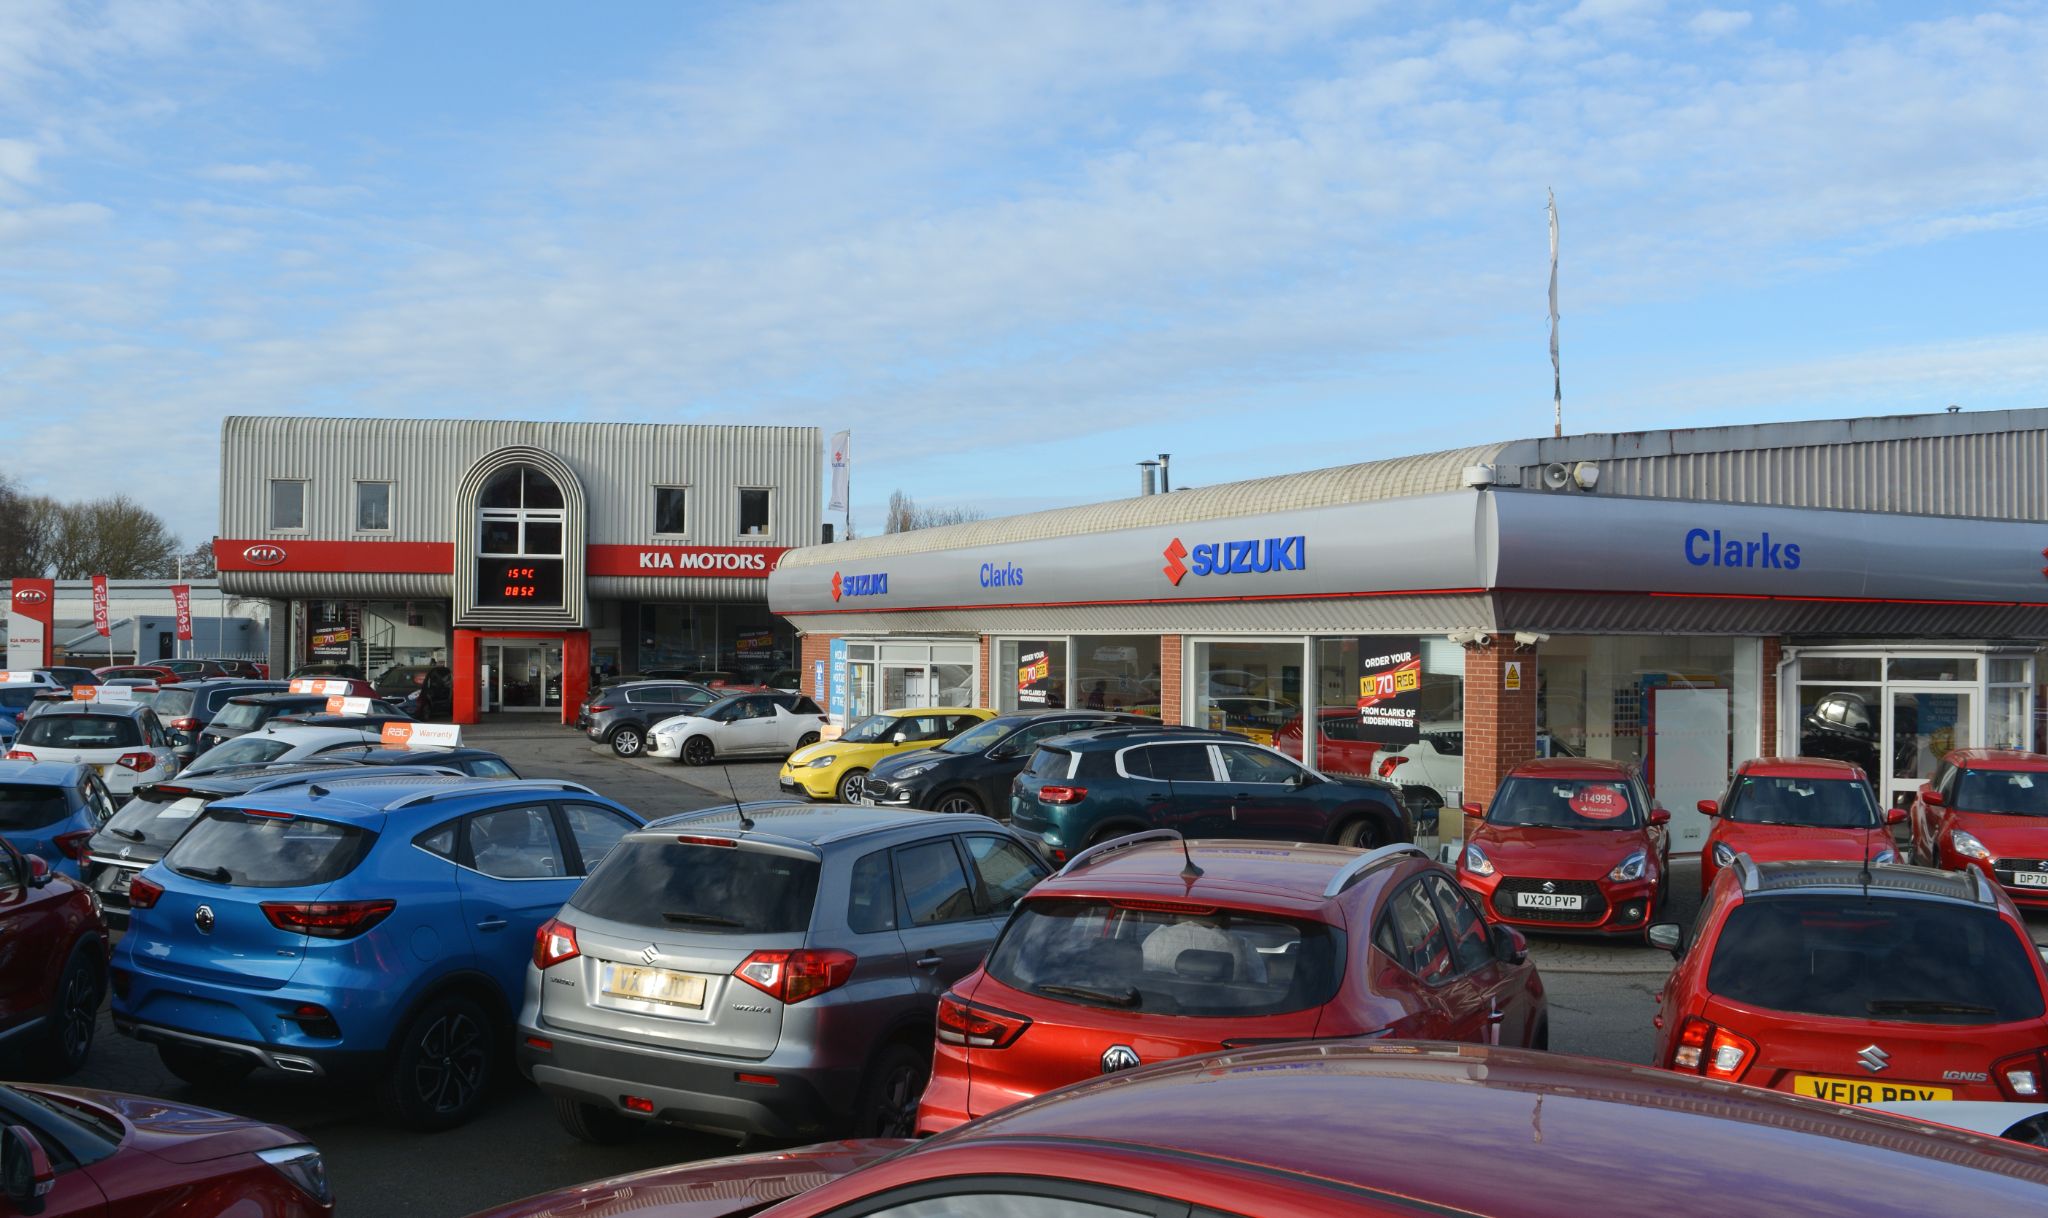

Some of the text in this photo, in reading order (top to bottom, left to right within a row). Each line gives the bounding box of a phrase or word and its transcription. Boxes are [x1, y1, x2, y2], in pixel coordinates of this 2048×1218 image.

[1192, 536, 1305, 576] SUZUKI
[1685, 528, 1800, 570] Clarks
[639, 553, 674, 568] KIA
[680, 553, 765, 569] MOTORS
[980, 562, 1023, 587] Clarks
[843, 573, 887, 596] SUZUKI
[324, 635, 334, 643] 70
[1365, 652, 1412, 668] ORDER YOUR
[1028, 666, 1036, 680] 70
[1363, 673, 1414, 694] NU 70 REG
[1362, 706, 1416, 718] FROM CLARKS OF
[1363, 716, 1414, 728] KIDDERMINSTER
[420, 729, 453, 740] Warranty
[1580, 793, 1613, 805] £14995
[1524, 894, 1577, 906] VX20 PVP
[1942, 1070, 1988, 1082] IGNIS
